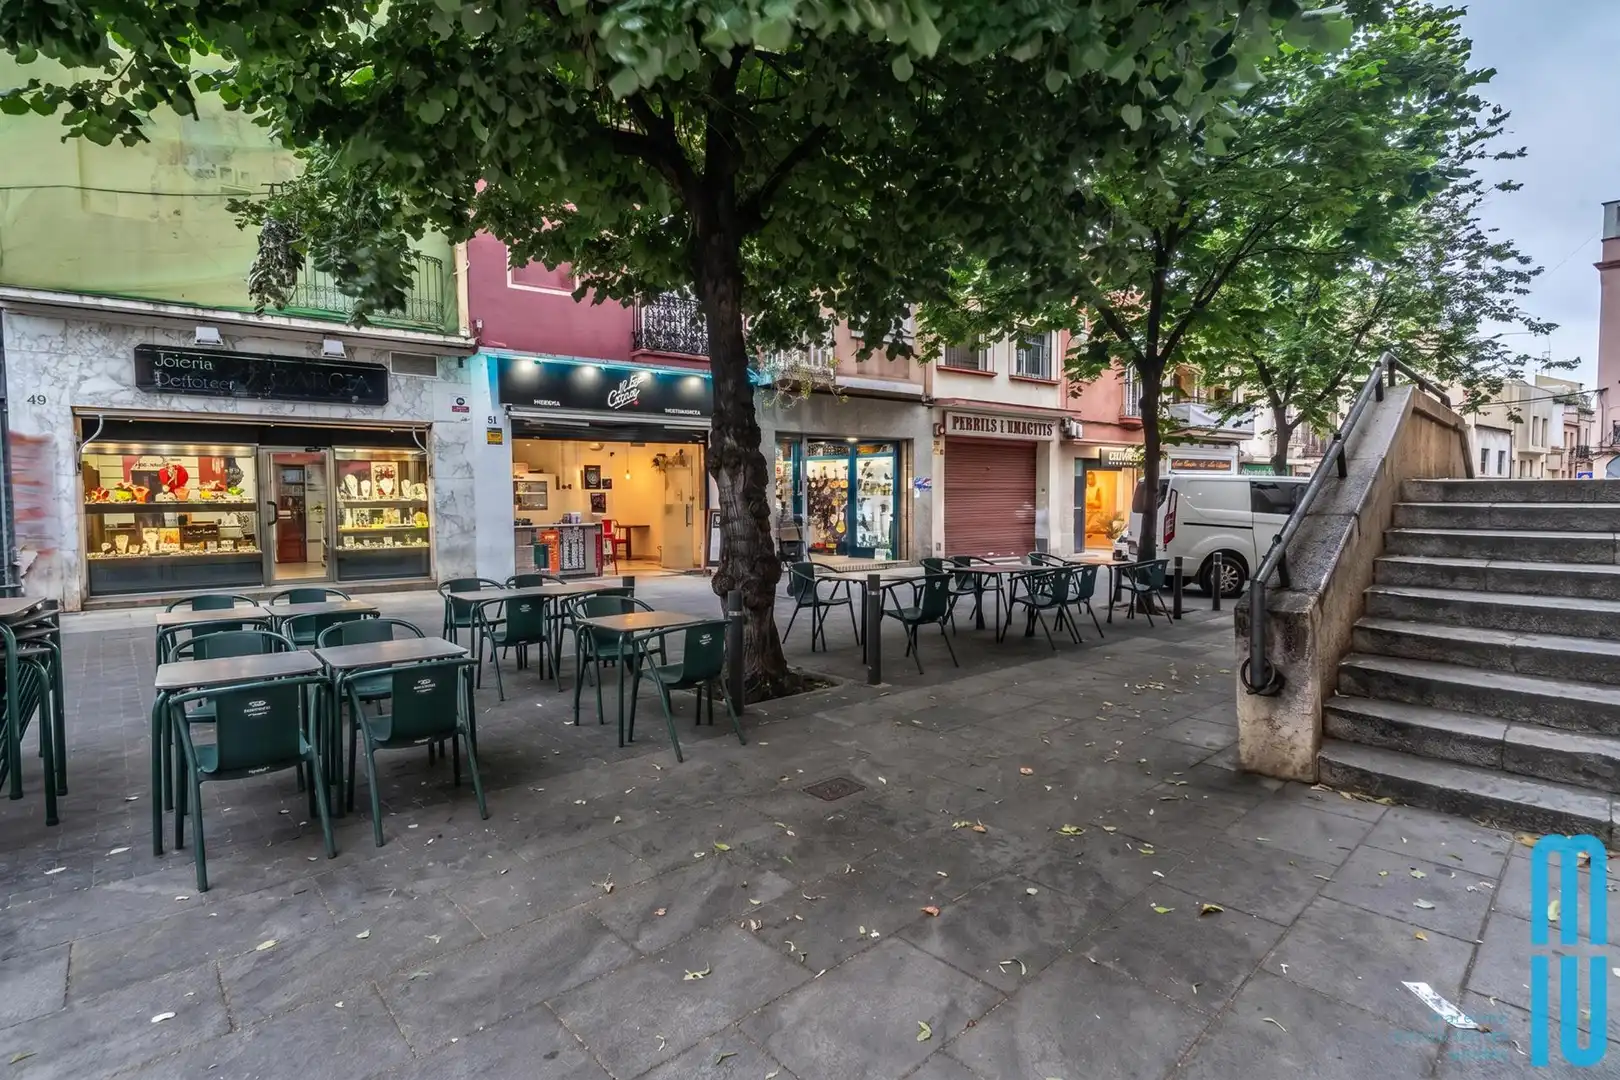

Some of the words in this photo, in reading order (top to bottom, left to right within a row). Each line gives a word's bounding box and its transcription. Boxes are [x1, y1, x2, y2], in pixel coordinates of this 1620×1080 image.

[154, 352, 213, 371] Joieria
[27, 394, 47, 405] 49
[487, 415, 498, 424] 51
